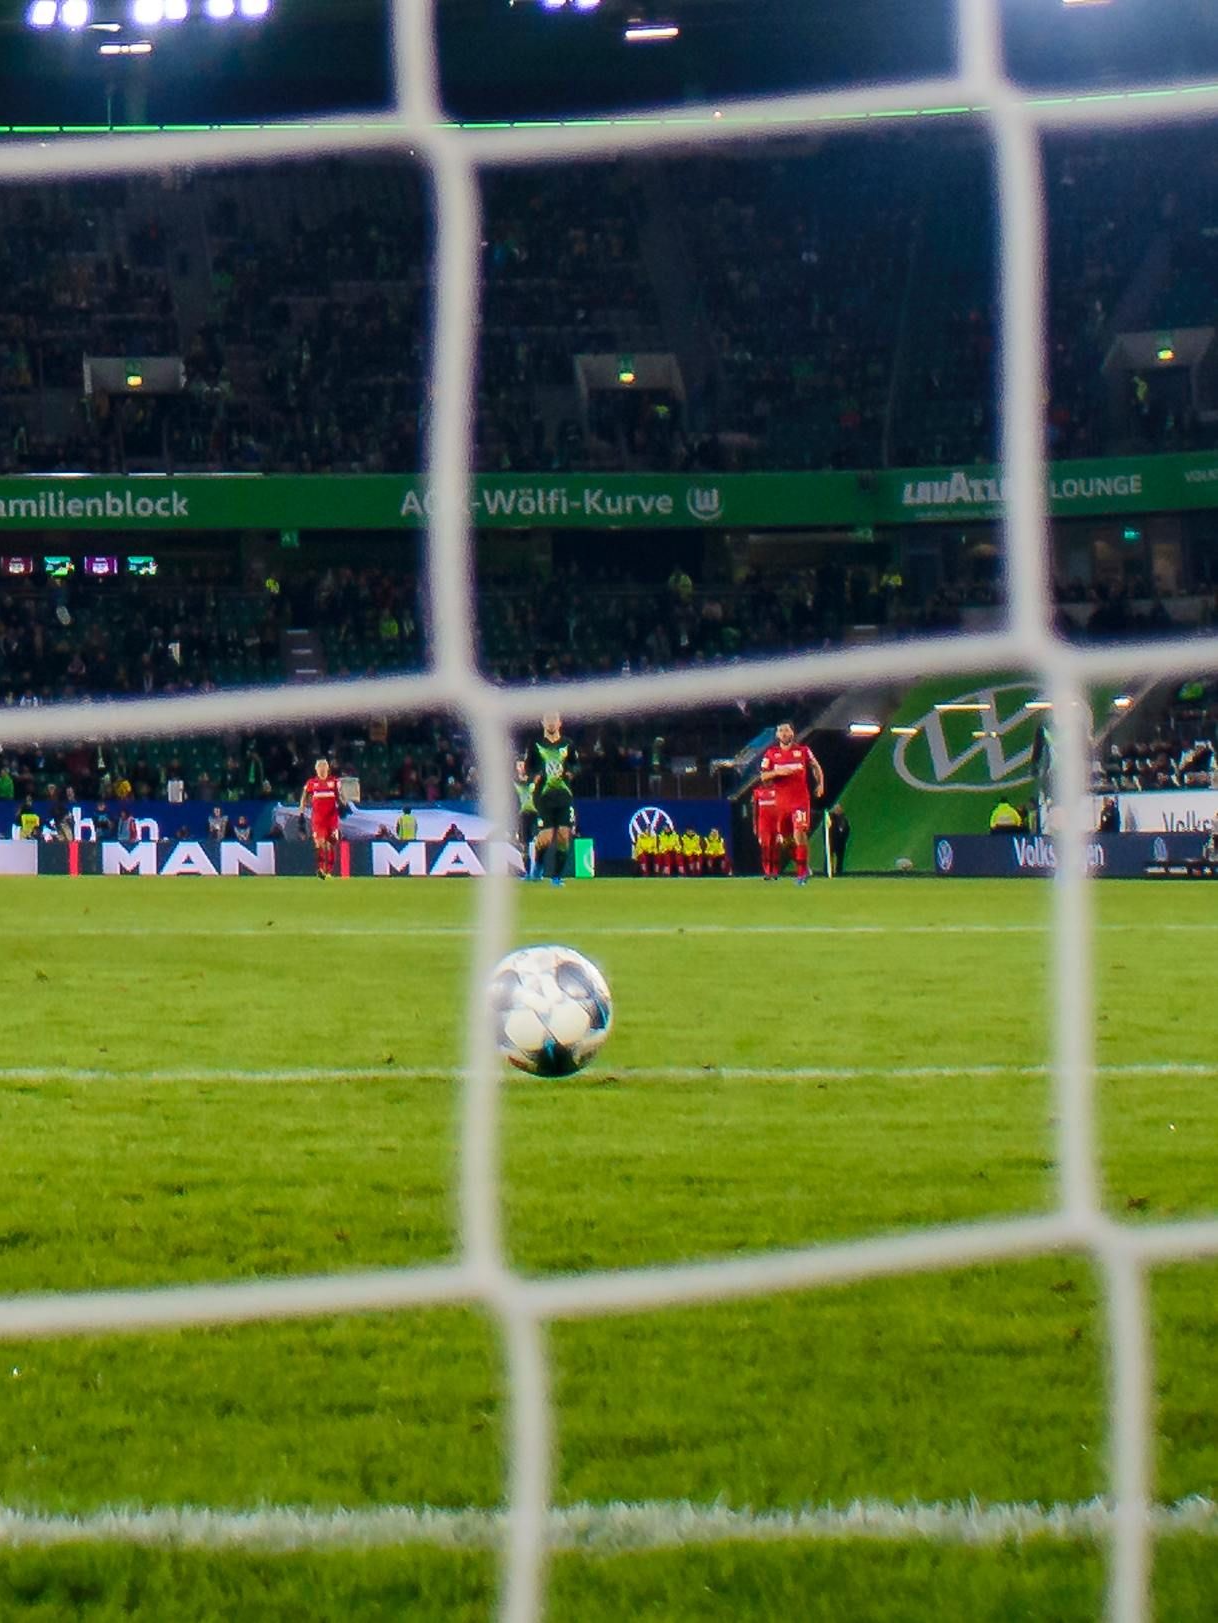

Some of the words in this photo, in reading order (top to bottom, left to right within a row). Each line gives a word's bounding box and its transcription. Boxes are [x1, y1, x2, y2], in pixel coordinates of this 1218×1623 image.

[400, 487, 673, 516] A-Wölfi-Kurve
[902, 472, 1008, 504] LAVAZZ
[1049, 475, 1143, 499] LOUNGE
[102, 841, 276, 875] MAN
